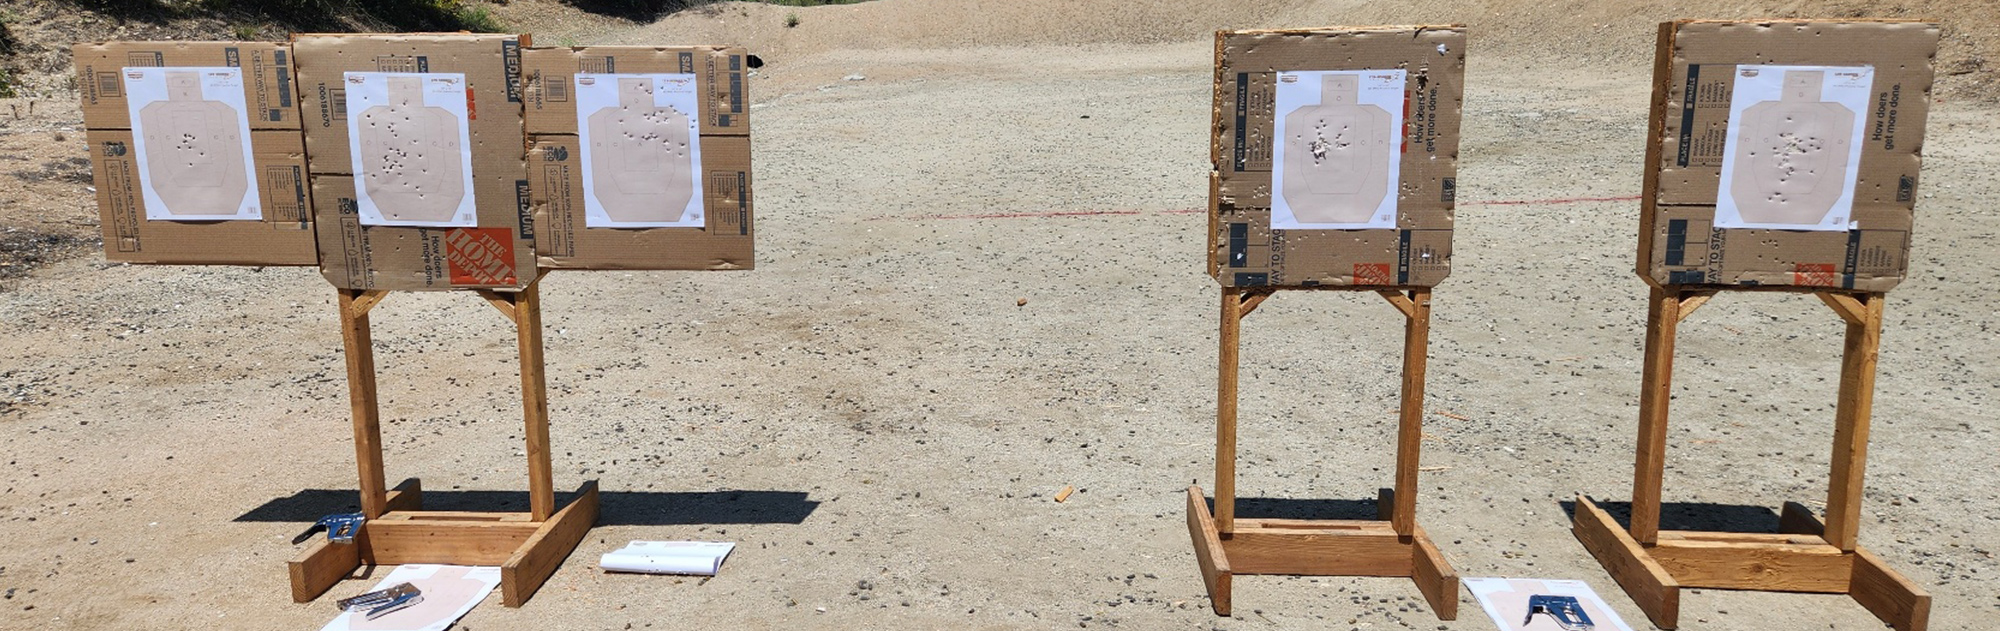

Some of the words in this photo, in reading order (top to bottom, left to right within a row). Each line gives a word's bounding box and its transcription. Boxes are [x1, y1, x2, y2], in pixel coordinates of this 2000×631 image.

[1687, 77, 1696, 102] FRAGILE
[1888, 82, 1901, 108] done.
[318, 82, 331, 128] 1006188670
[1415, 96, 1426, 122] doers
[1875, 92, 1888, 118] doers
[1427, 113, 1435, 136] more
[1872, 120, 1884, 141] How
[1886, 110, 1897, 133] more
[1413, 124, 1423, 144] How
[1426, 137, 1436, 153] get
[1884, 135, 1895, 150] get
[1679, 144, 1689, 163] PLACE
[342, 197, 351, 215] ECO
[518, 185, 534, 235] MEDIUM
[422, 243, 431, 264] more
[431, 235, 441, 254] How
[480, 233, 507, 258] THE
[433, 255, 443, 279] doers
[446, 228, 516, 285] HOME
[447, 250, 496, 285] DEPOT
[1271, 254, 1280, 267] TO
[1708, 252, 1719, 266] TO
[425, 265, 435, 288] done.
